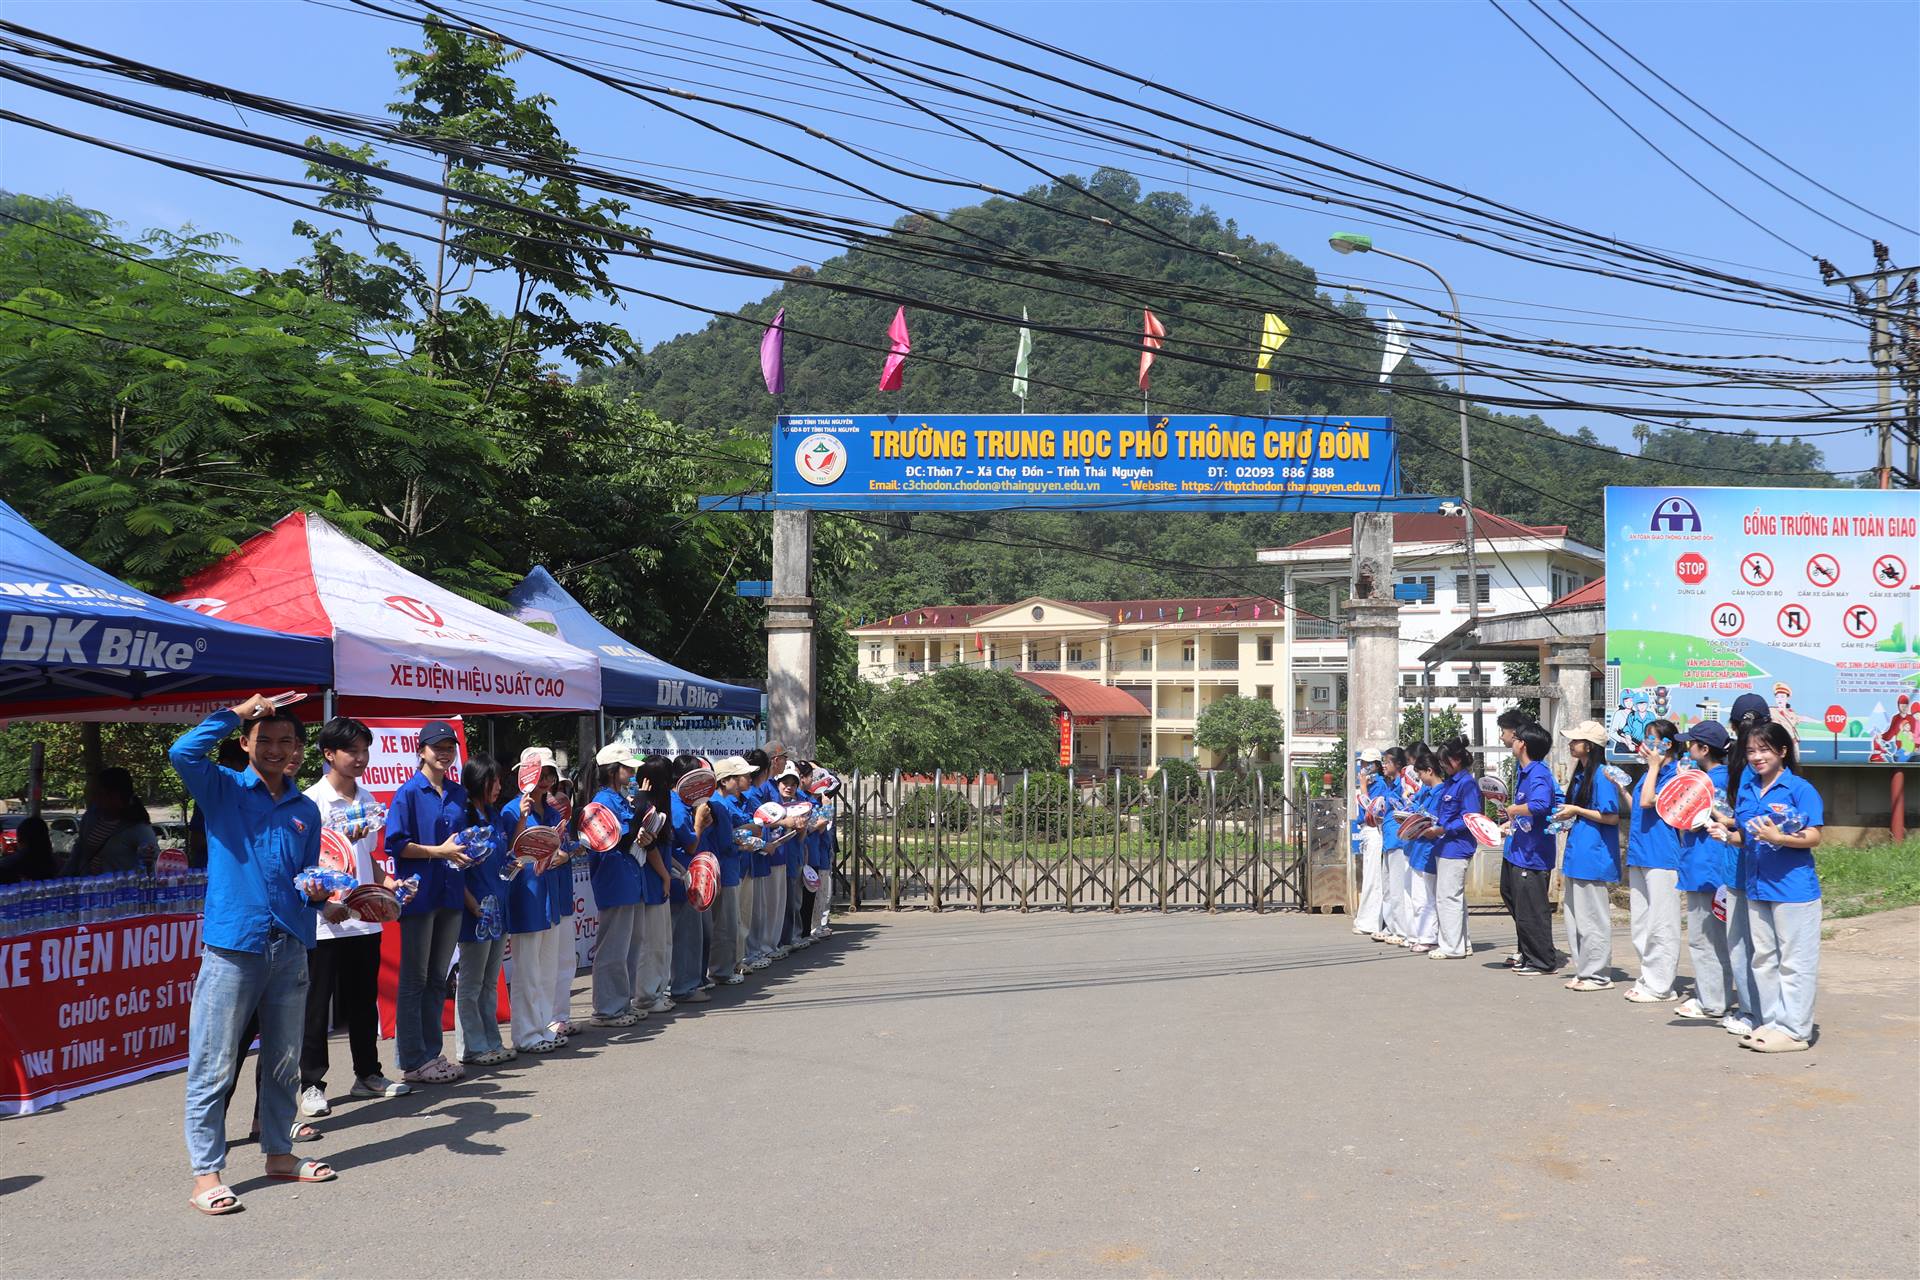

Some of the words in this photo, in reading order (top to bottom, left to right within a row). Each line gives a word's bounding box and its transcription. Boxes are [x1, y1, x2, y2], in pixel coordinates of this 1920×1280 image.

[870, 423, 967, 459] TRƯỜNG
[974, 430, 1055, 459] TRUNG
[1063, 430, 1112, 464] HỌC
[1119, 417, 1169, 459] PHỔ
[1175, 424, 1256, 460] THÔNG
[1264, 428, 1313, 465] CHỢ
[1319, 421, 1370, 460] ĐỒN
[869, 480, 900, 491] Email:
[903, 480, 1100, 493] c3chodon.chodon@thainguyen.edu.vn
[1131, 480, 1177, 491] Website:
[906, 466, 926, 477] ĐC:
[928, 466, 953, 477] Thôn
[955, 466, 962, 477] 7
[977, 466, 992, 477] Xã
[996, 466, 1016, 480] Chợ
[1021, 465, 1044, 477] Đồn
[1057, 466, 1080, 477] Tỉnh
[1084, 466, 1107, 477] Thái
[1112, 466, 1153, 480] Nguyên
[1208, 467, 1228, 477] ĐT:
[1236, 467, 1274, 478] 02093
[1282, 468, 1305, 478] 886
[1312, 468, 1334, 478] 388
[1743, 506, 1776, 535] CỔNG
[1780, 512, 1828, 536] TRƯỜNG
[1832, 516, 1849, 536] AN
[1852, 513, 1884, 537] TOÀN
[1888, 518, 1916, 537] GIAO
[1679, 562, 1704, 575] STOP
[1719, 613, 1737, 627] 40
[1, 615, 99, 664] DK
[390, 664, 413, 686] XE
[416, 662, 454, 694] ĐIỆN
[458, 666, 491, 697] HIỆU
[495, 669, 532, 696] SUẤT
[535, 677, 564, 697] CAO
[656, 679, 685, 707] DK
[1827, 715, 1846, 723] STOP
[381, 735, 398, 753] XE
[362, 763, 413, 785] NGUYÊN
[41, 926, 114, 987] ĐIỆN
[59, 993, 110, 1029] CHÚC
[115, 986, 151, 1017] CÁC
[156, 980, 173, 1009] SĨ
[61, 1039, 105, 1071] TĨNH
[123, 1026, 146, 1058] TỰ
[149, 1023, 176, 1049] TIN
